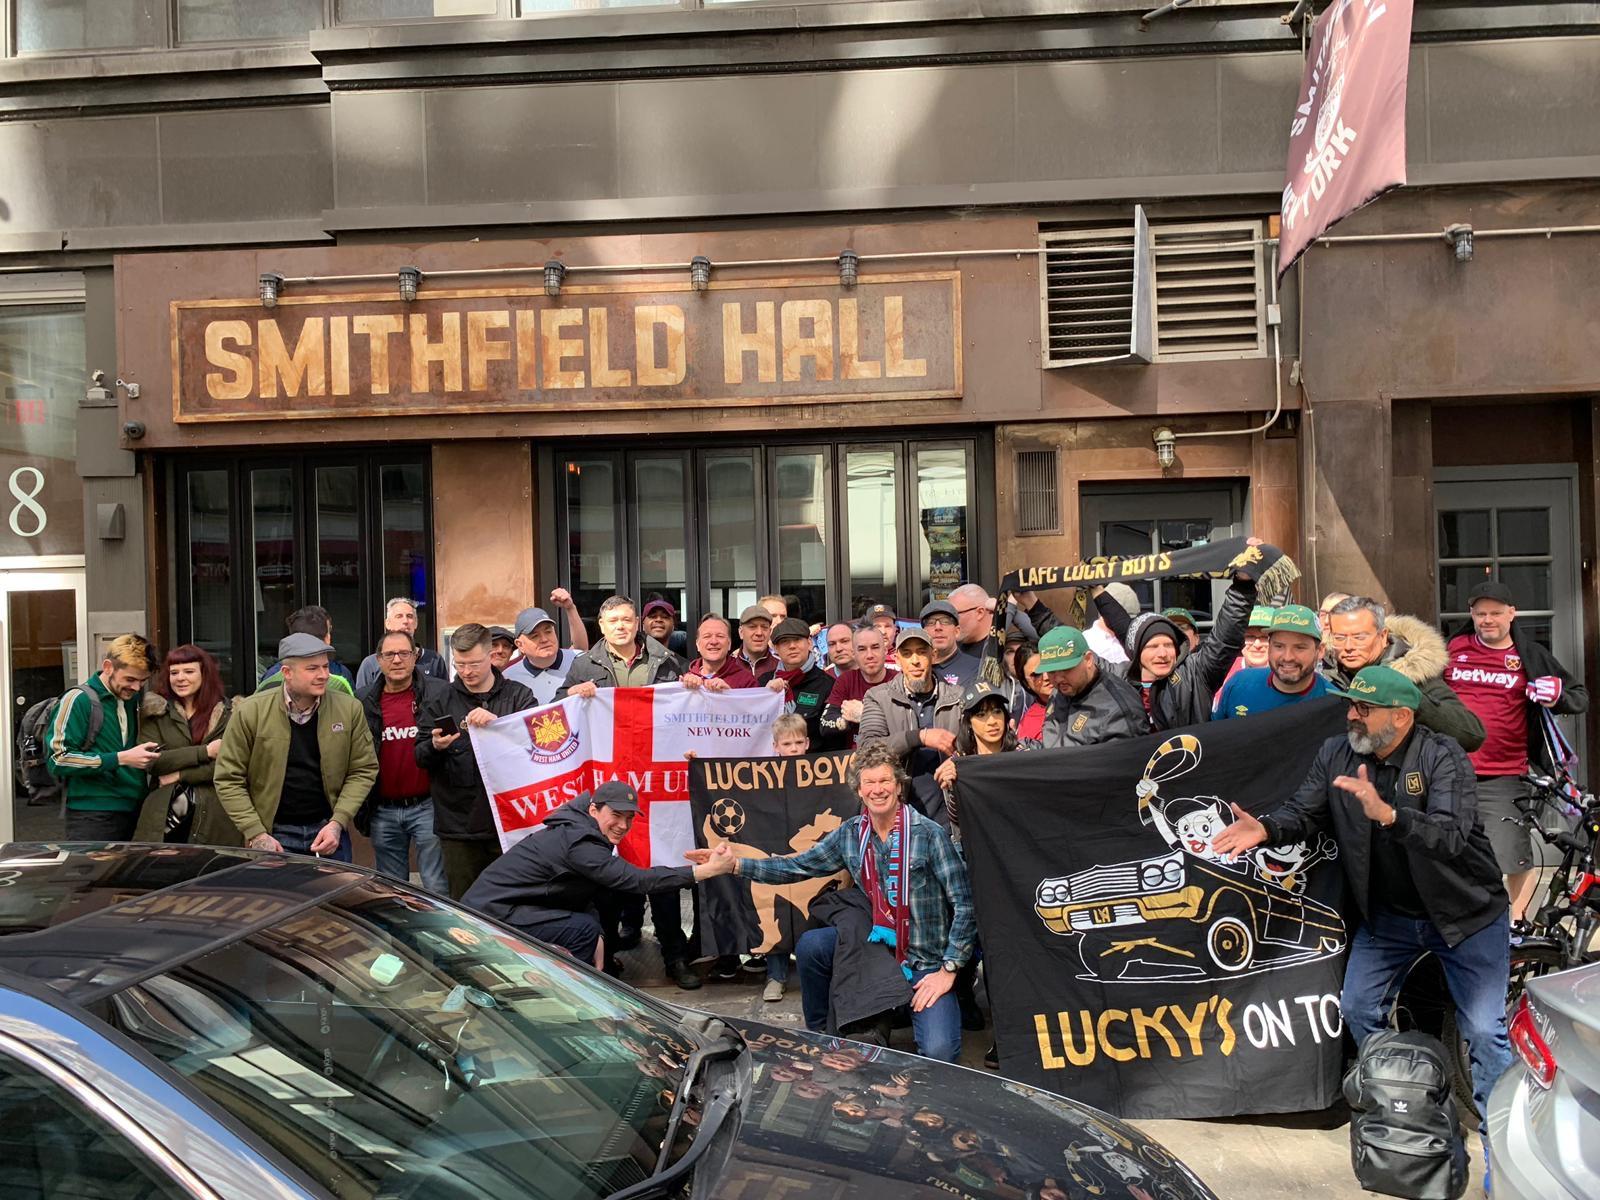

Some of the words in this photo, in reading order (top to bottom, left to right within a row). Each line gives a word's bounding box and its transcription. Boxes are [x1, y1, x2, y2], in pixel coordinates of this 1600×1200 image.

[1302, 117, 1358, 218] YORK
[204, 304, 688, 400] SMITHFIELD
[722, 295, 927, 384] HALL
[8, 467, 47, 537] 8
[1121, 551, 1173, 577] BOYS
[1451, 667, 1519, 689] betway
[664, 713, 739, 723] SMITHFIELD
[687, 727, 713, 737] NEW
[716, 727, 751, 738] YORK
[533, 754, 548, 763] WEST
[548, 754, 562, 763] HAM
[562, 741, 578, 758] UNITED
[704, 760, 788, 791] LUCKY
[510, 771, 587, 820] WEST
[1033, 994, 1234, 1070] LUCKY'S
[1243, 996, 1295, 1050] ON
